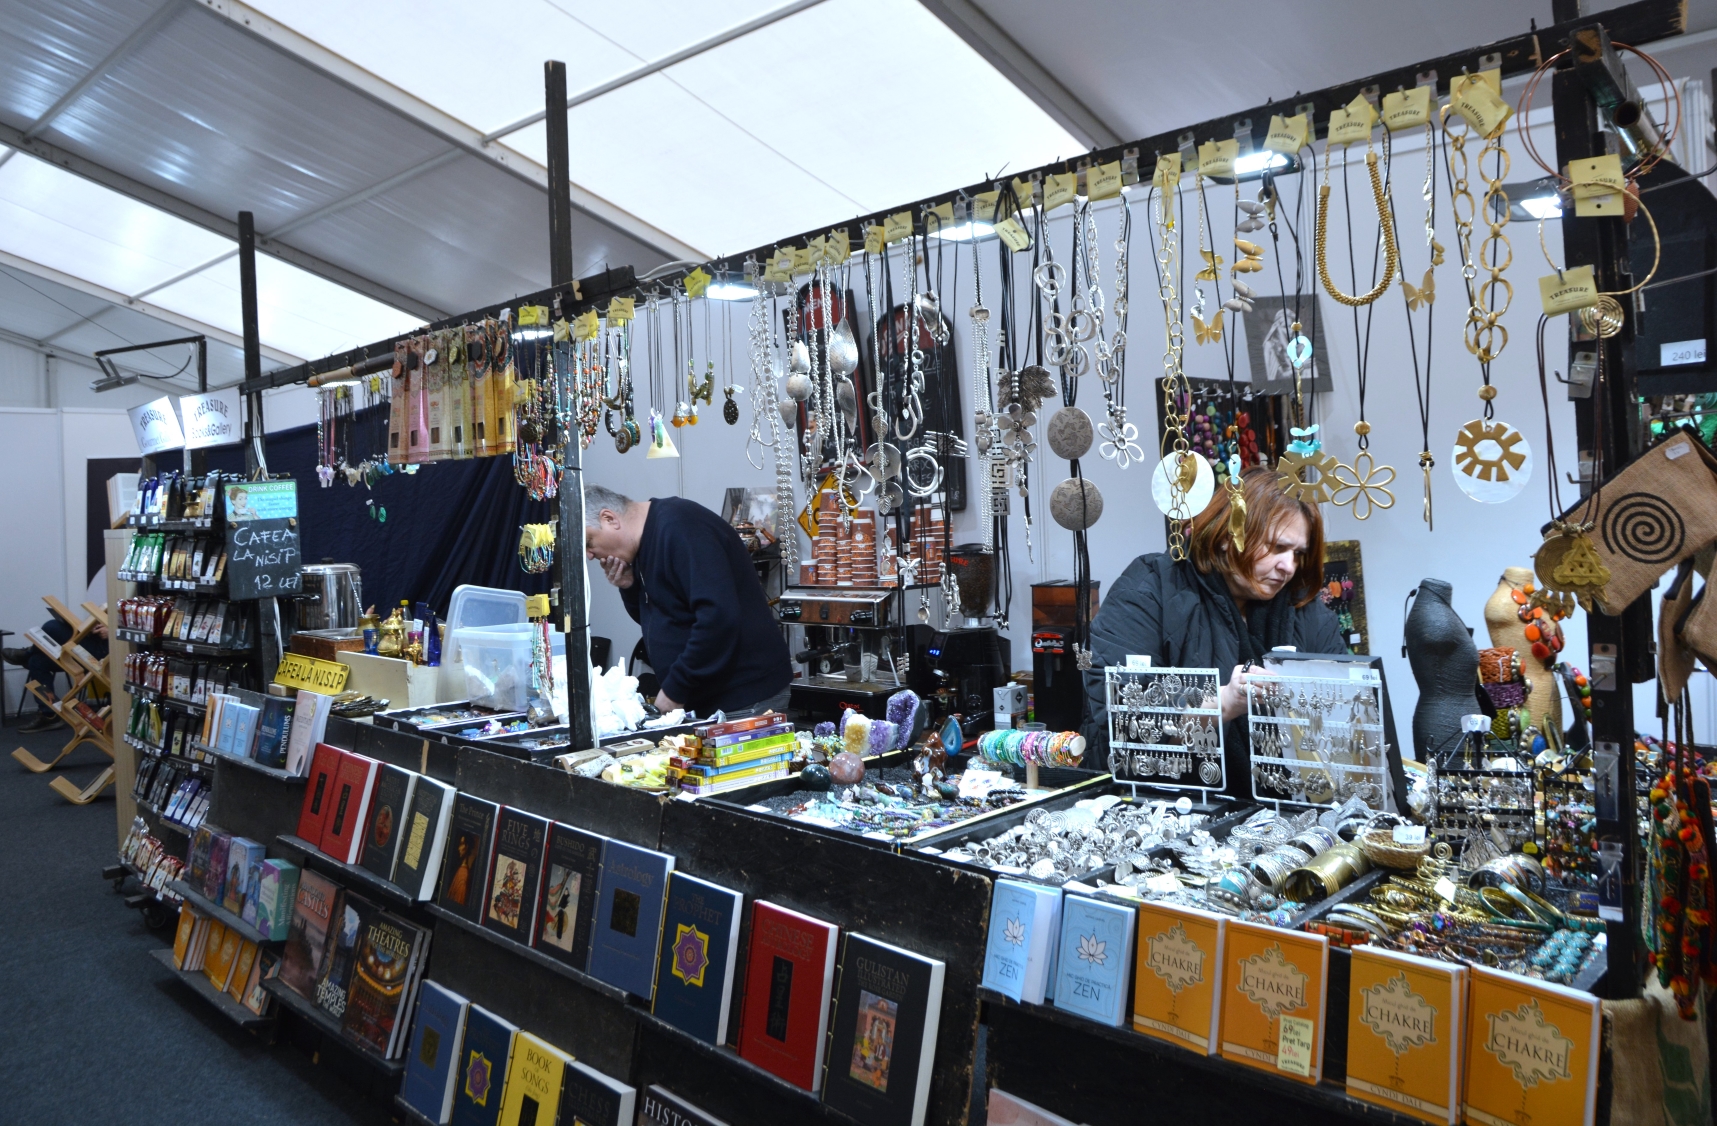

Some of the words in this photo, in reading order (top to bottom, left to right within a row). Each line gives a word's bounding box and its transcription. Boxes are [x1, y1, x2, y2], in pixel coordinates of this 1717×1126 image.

[1389, 110, 1420, 120] TREASURE
[1461, 101, 1485, 127] TREASURE
[1335, 122, 1364, 132] TREASURE
[1549, 286, 1589, 300] TREASURE
[1672, 350, 1691, 361] 240
[193, 398, 229, 422] TREASURE
[248, 485, 268, 493] DRINK
[270, 483, 293, 492] COFFEE
[233, 527, 298, 546] CAFEA
[233, 549, 255, 561] LA
[254, 574, 272, 590] 12
[313, 668, 344, 690] NISIP
[280, 715, 291, 754] PENDULUMS
[501, 829, 531, 850] RINGS
[507, 818, 529, 837] FIVE
[556, 835, 585, 852] BUSHIDO
[607, 860, 655, 888] Astrology
[298, 888, 329, 919] CASTLES
[673, 894, 723, 925] PROPHET
[368, 924, 410, 958] THEATRES
[380, 922, 403, 939] AMAZING
[761, 918, 815, 947] CHINESE
[856, 956, 911, 987] GULISTAN
[998, 961, 1019, 981] ZEN
[1151, 951, 1201, 975] CHAKRE
[321, 977, 347, 1000] AMAZING
[857, 970, 907, 995] ILLUSTRATED
[1073, 980, 1101, 1002] ZEN
[1244, 974, 1302, 1000] CHAKRE
[317, 984, 347, 1014] TEMPLES
[1151, 1021, 1175, 1034] CYNDI
[1176, 1028, 1192, 1041] DALE
[1367, 1005, 1430, 1034] CHAKRE
[1298, 1037, 1311, 1051] Targ
[1493, 1032, 1565, 1069] CHAKRE
[526, 1048, 553, 1074] BOOK
[520, 1067, 551, 1096] SONGS
[568, 1082, 612, 1119] CHESS
[1370, 1085, 1399, 1102] CYNDI
[1401, 1092, 1422, 1109] DALE
